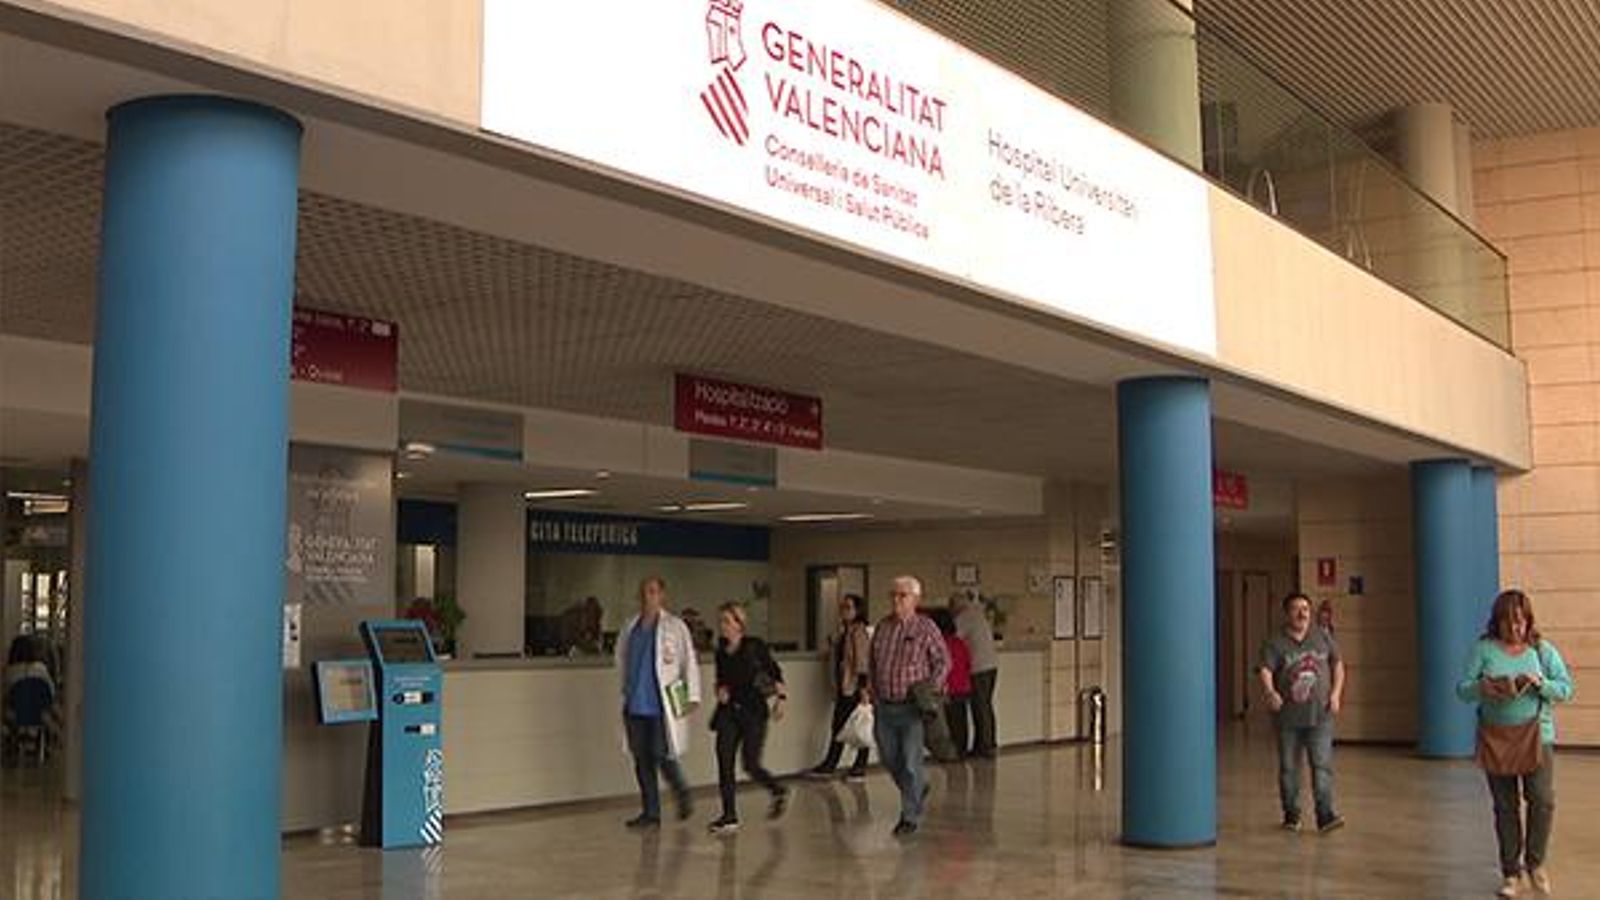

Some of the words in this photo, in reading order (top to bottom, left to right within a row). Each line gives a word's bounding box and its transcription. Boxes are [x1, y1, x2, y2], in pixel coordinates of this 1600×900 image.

[762, 22, 946, 132] GENERALITAT
[765, 72, 945, 180] VALENCIANA
[989, 127, 1057, 182] Hospital
[766, 165, 835, 207] Universal
[845, 192, 880, 223] Salut
[853, 167, 869, 190] de
[989, 172, 1013, 206] de
[1035, 190, 1085, 235] Ribera
